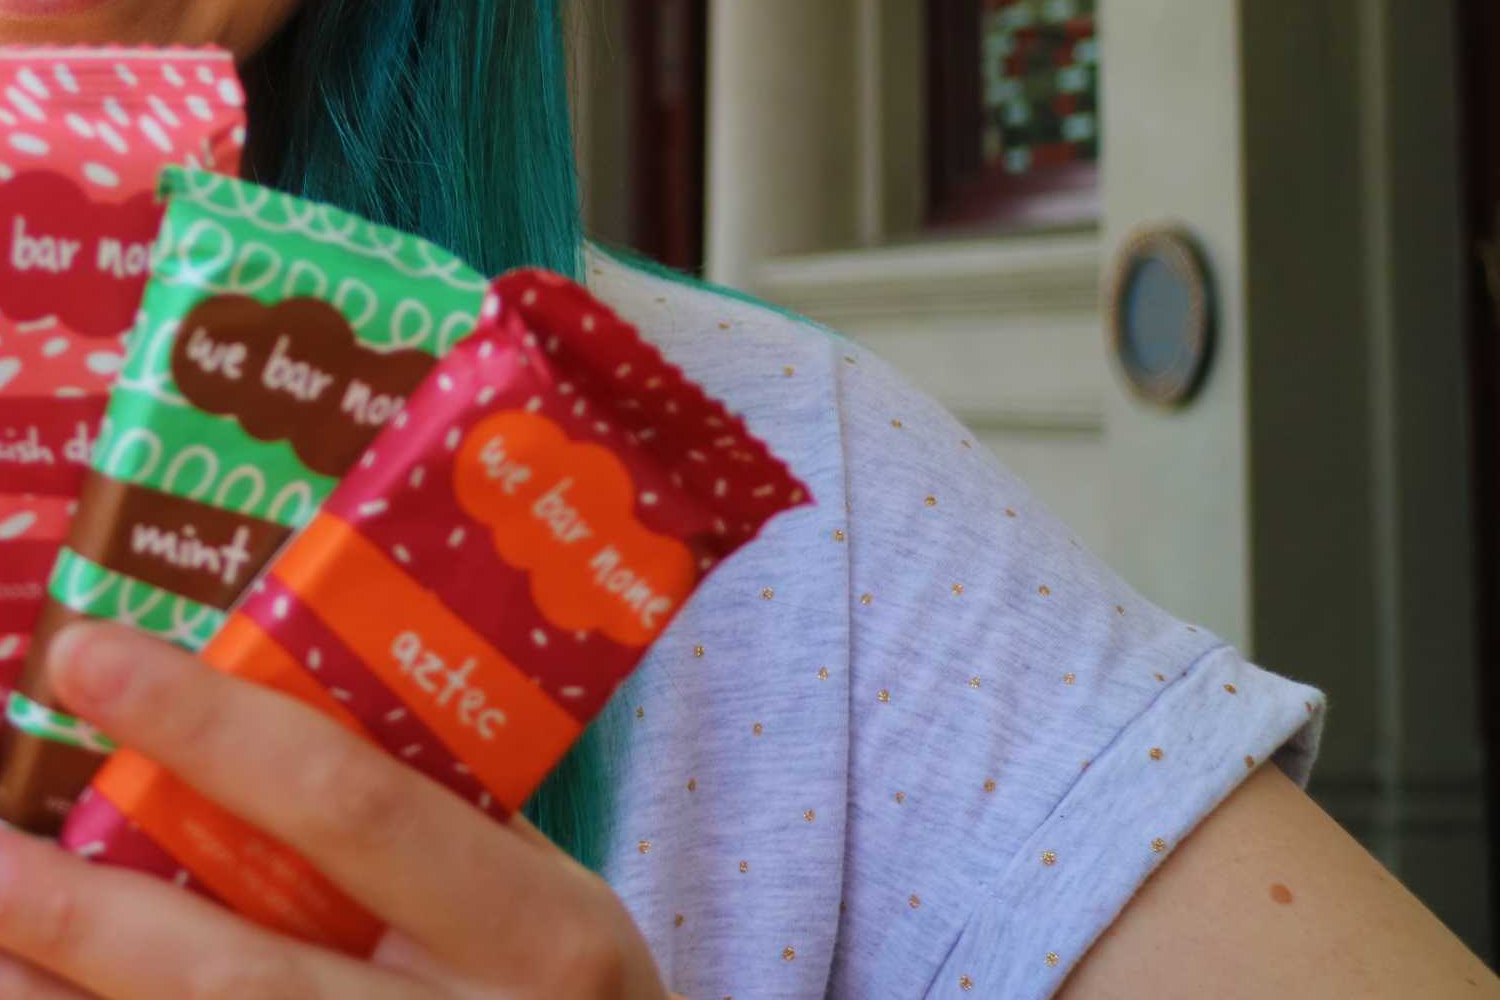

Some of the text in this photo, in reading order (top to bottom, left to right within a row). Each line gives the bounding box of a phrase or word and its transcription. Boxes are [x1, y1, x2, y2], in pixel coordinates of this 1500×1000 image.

[12, 215, 80, 271] bar
[97, 237, 157, 279] no
[185, 327, 248, 381] we
[261, 334, 334, 401] bar
[130, 523, 250, 585] mint
[478, 434, 673, 631] we bar none
[388, 629, 509, 741] aztec
